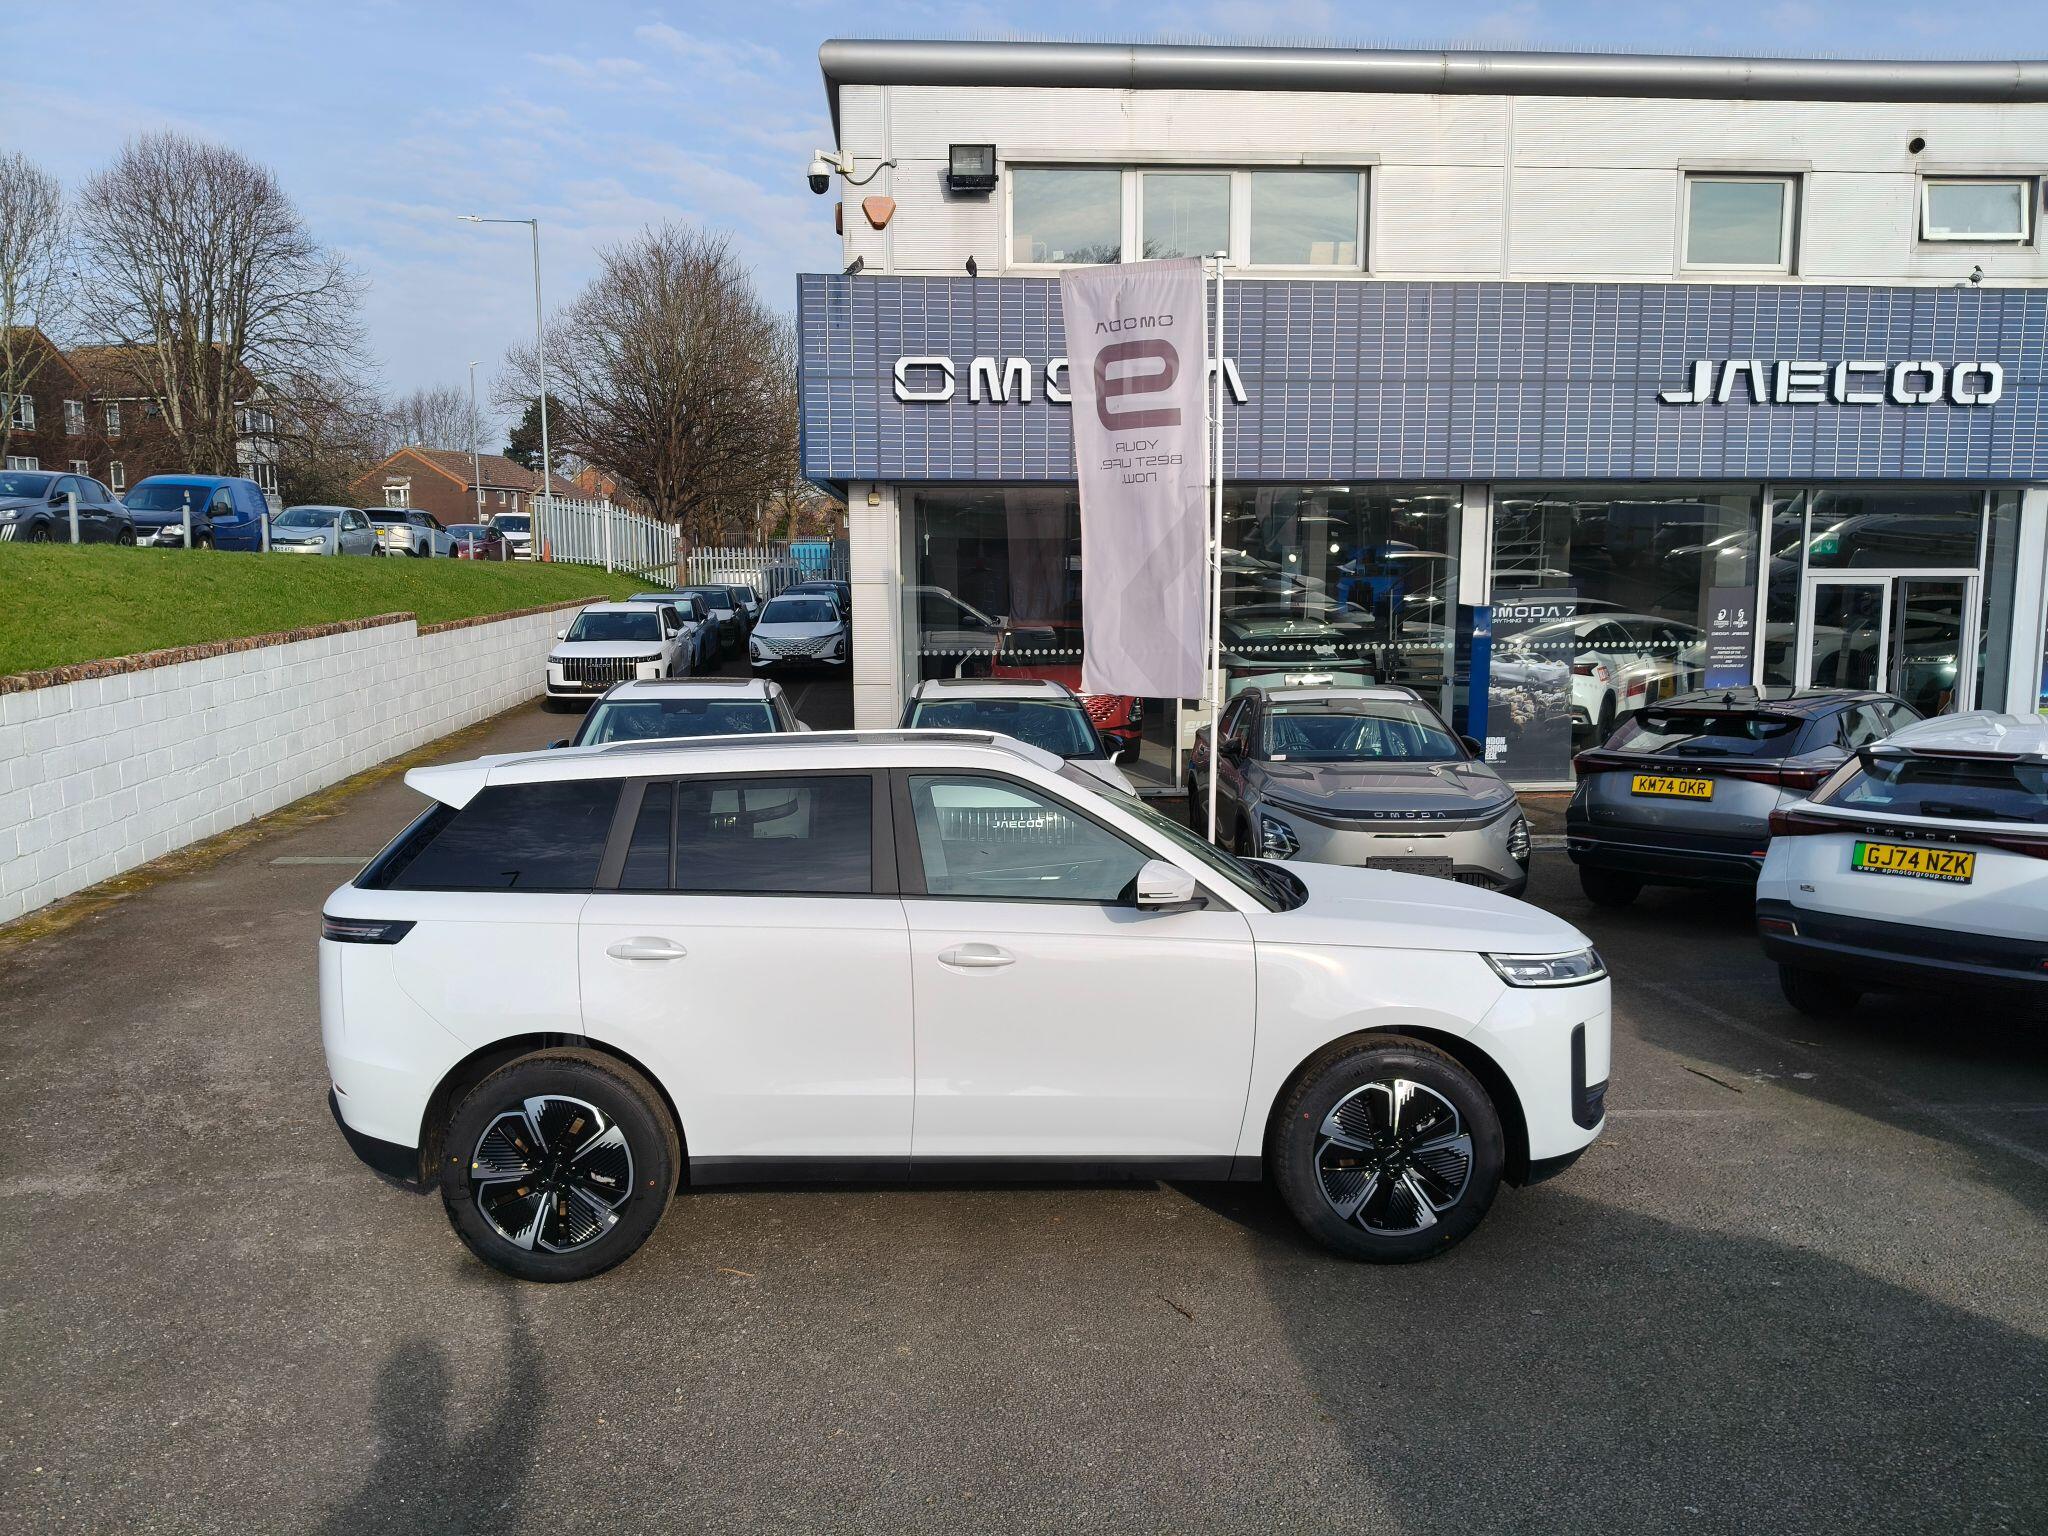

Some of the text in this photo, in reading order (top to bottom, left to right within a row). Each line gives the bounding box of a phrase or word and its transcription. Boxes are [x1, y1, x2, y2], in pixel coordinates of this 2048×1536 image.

[893, 356, 1249, 403] OMA
[1660, 360, 2004, 404] JAECOO
[1565, 605, 1576, 617] 7
[1639, 778, 1706, 794] KM74 OKR
[992, 819, 1044, 829] JAECOO
[1868, 847, 1969, 874] GJ74 NZK
